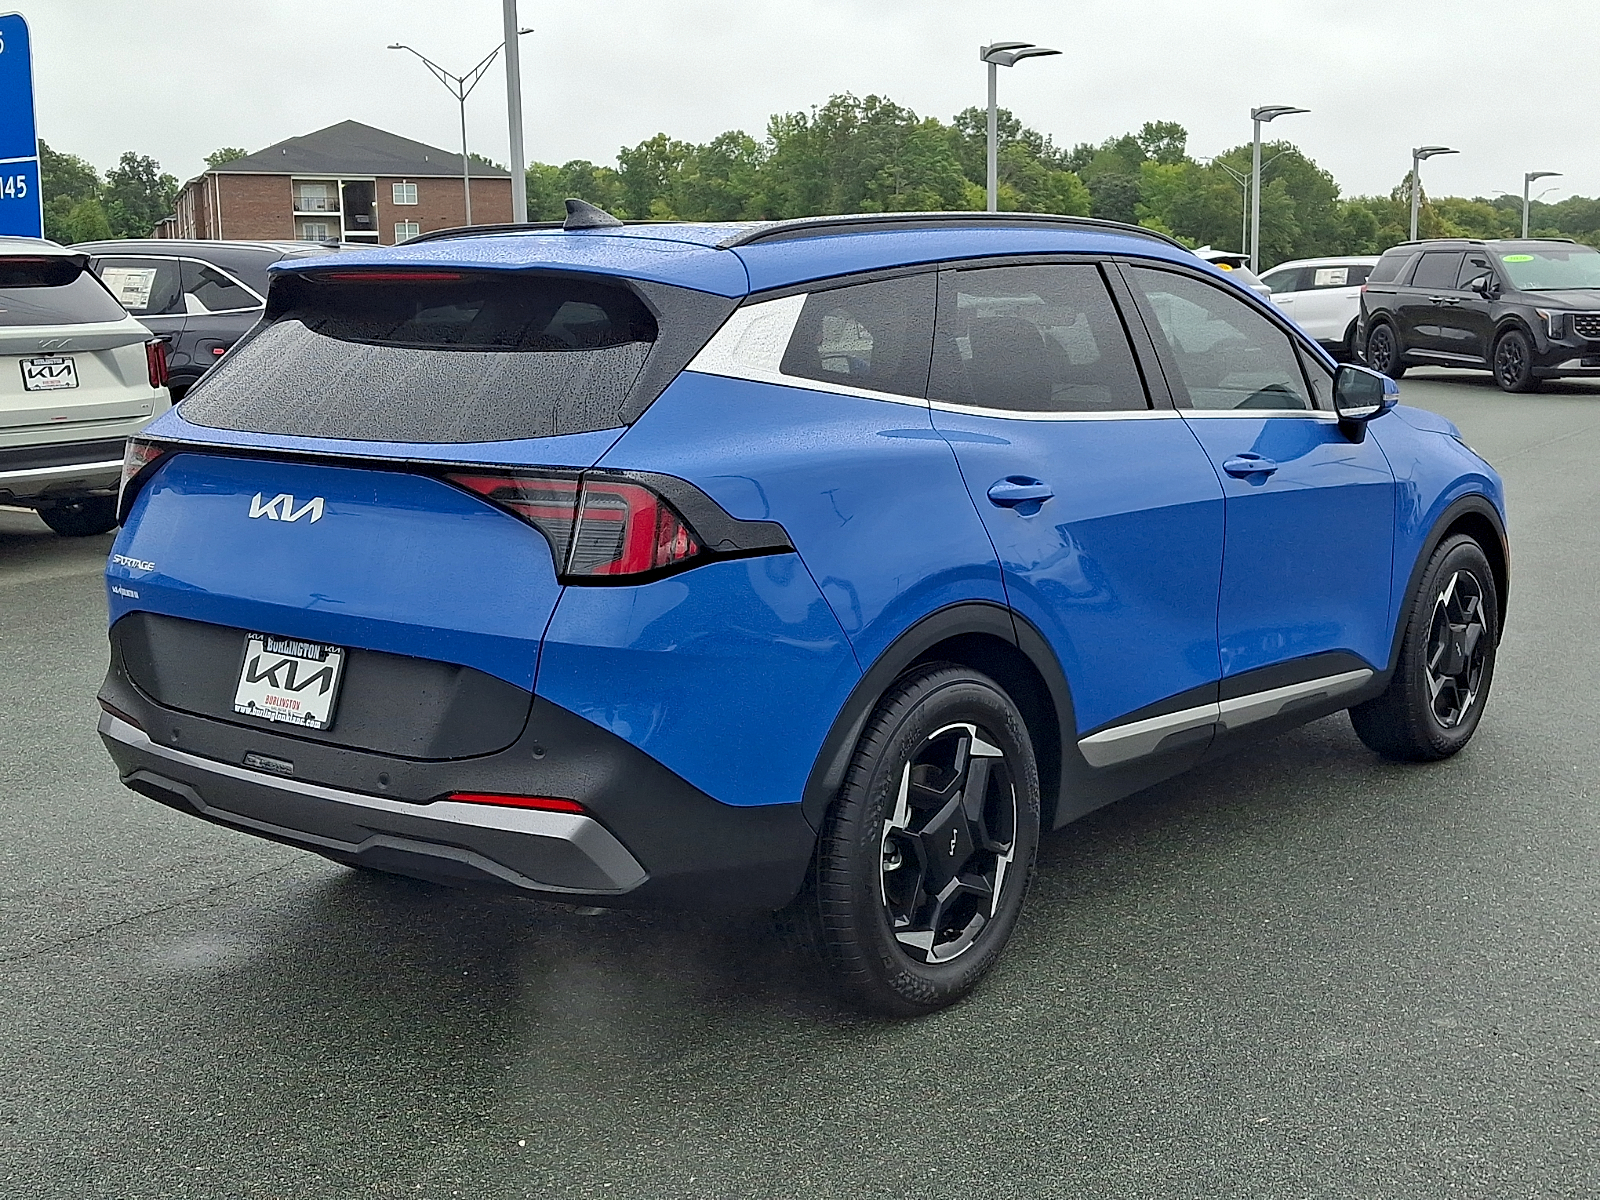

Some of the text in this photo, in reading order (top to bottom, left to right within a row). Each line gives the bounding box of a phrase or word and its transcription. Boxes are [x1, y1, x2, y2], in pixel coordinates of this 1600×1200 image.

[28, 365, 71, 379] KIA
[249, 491, 325, 524] KIA
[112, 553, 156, 572] SPORTAGE
[266, 637, 321, 660] BURLINGTON
[246, 653, 333, 697] KIA
[264, 694, 301, 711] BURLINGTON
